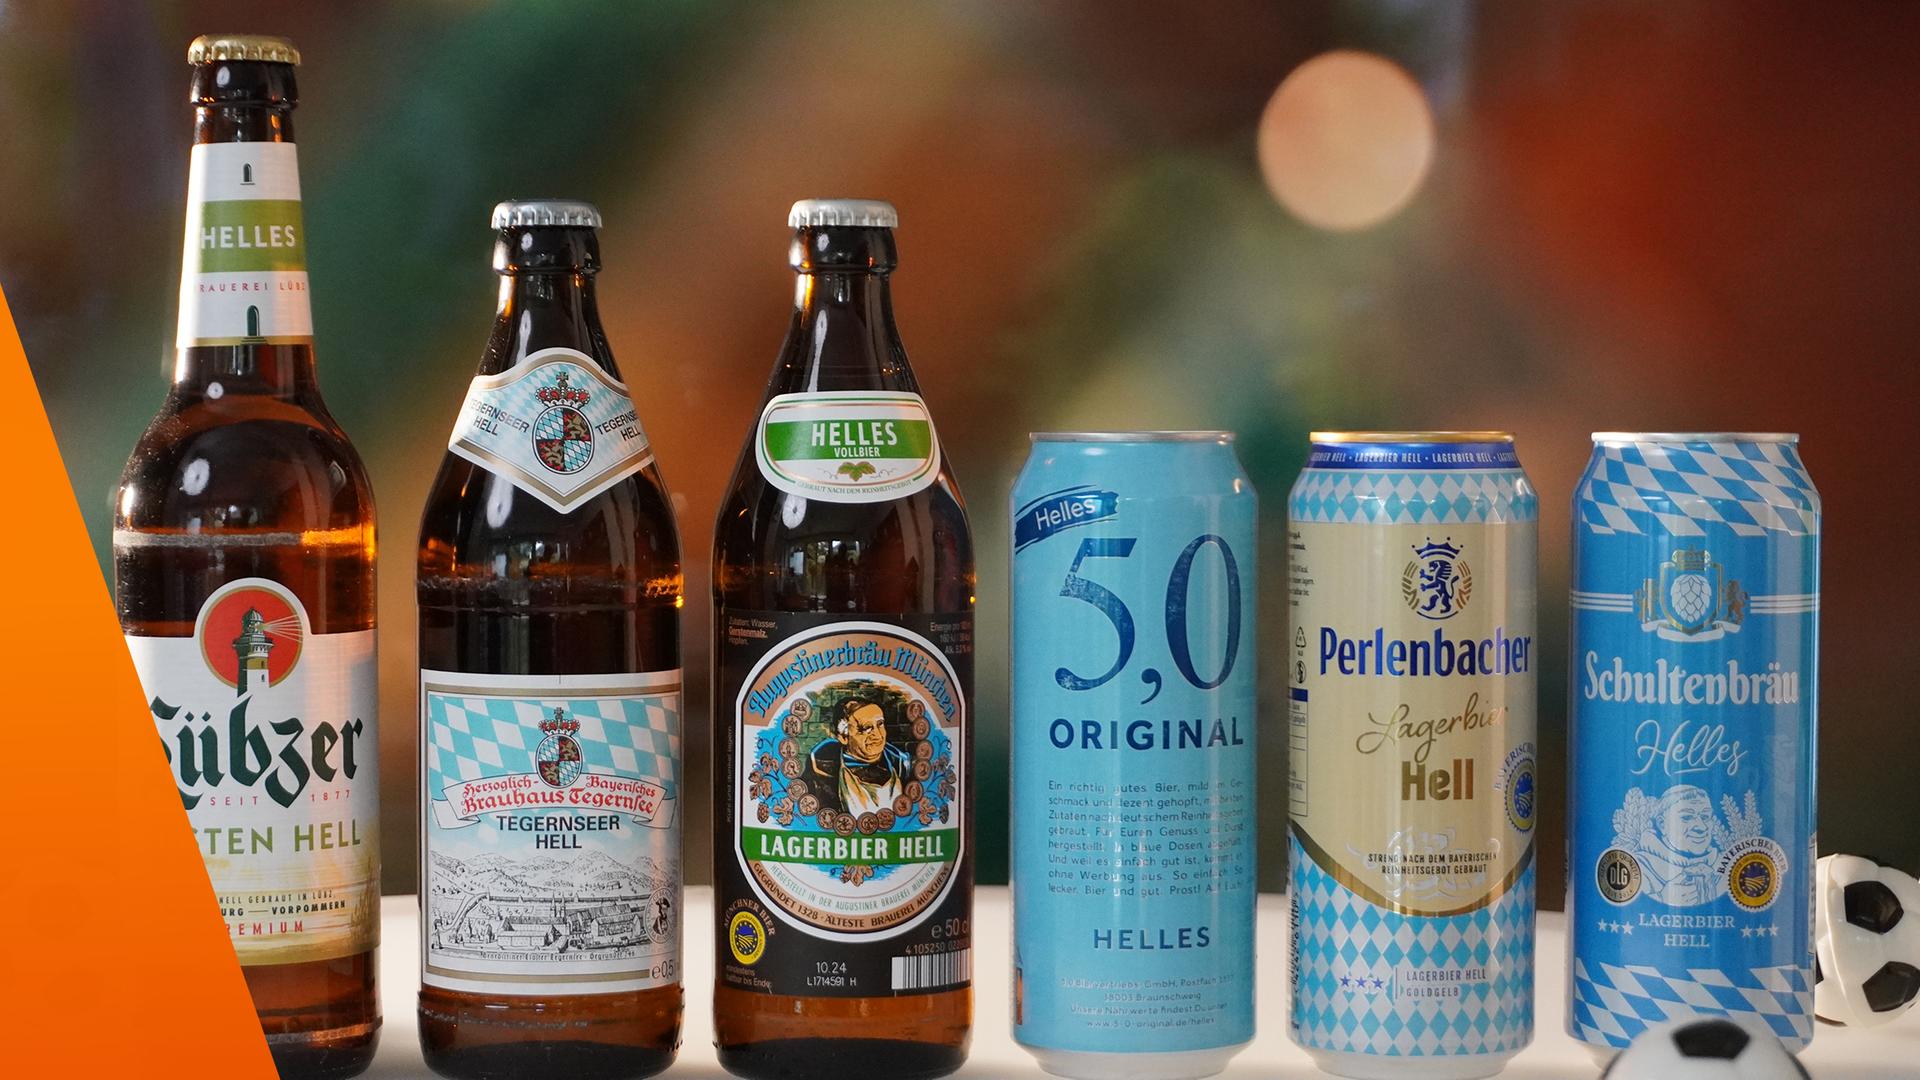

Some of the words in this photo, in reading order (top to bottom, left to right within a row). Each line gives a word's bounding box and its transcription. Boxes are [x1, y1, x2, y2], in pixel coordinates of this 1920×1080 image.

[200, 225, 296, 249] HELLES
[199, 282, 269, 292] RAUEREI
[473, 416, 498, 437] HELL
[621, 426, 641, 441] HELL
[811, 422, 898, 447] HELLES
[834, 447, 881, 458] VOLLBIER
[1331, 452, 1346, 462] HELL
[1354, 451, 1398, 463] LAGERBIER
[1402, 452, 1421, 463] HELL
[1432, 452, 1475, 463] LAGERBIER
[1477, 452, 1493, 463] HELL
[1036, 496, 1097, 532] Helles
[1054, 533, 1242, 706] 5,0
[1320, 627, 1531, 676] Perlenbacher
[748, 640, 891, 719] Augustinerbräu
[892, 647, 956, 721] München
[1584, 650, 1799, 705] Schultenbräu
[1049, 717, 1244, 750] ORIGINAL
[1631, 719, 1748, 777] Helles
[1048, 780, 1062, 790] Ein
[1069, 782, 1105, 794] richtig
[1188, 781, 1209, 791] mild
[1402, 758, 1474, 801] Hell
[210, 796, 259, 806] SEIT
[311, 789, 351, 802] 1877
[461, 788, 565, 816] Brauhaus
[1048, 796, 1088, 807] schmack
[1092, 798, 1113, 808] und
[1157, 796, 1203, 809] gehopft,
[1048, 809, 1087, 820] Zutaten
[1088, 811, 1115, 822] nach
[496, 815, 620, 832] TEGERNSEER
[193, 826, 273, 855] TEN
[294, 819, 361, 853] HELL
[1120, 826, 1153, 837] Euren
[1160, 826, 1199, 837] Genuss
[536, 834, 582, 849] HELL
[761, 834, 888, 860] LAGERBIER
[899, 835, 944, 858] HELL
[1168, 841, 1203, 851] Dosen
[1048, 854, 1067, 864] Und
[1072, 856, 1092, 865] weil
[1096, 858, 1109, 866] es
[1115, 856, 1156, 867] einfach
[1161, 857, 1180, 868] gut
[1368, 853, 1399, 863] STRENG
[1403, 853, 1425, 864] NACH
[1428, 853, 1446, 864] DEM
[1717, 838, 1773, 874] BAYERISCHES
[1048, 869, 1074, 879] ohne
[1080, 870, 1135, 883] Werbung
[1173, 870, 1188, 880] So
[1381, 864, 1451, 875] REINHEITSGEBOT
[1454, 863, 1487, 874] GEBRAUT
[1610, 861, 1628, 885] DLG
[770, 864, 806, 897] HERGESTELLT
[808, 893, 817, 902] IN
[819, 897, 832, 907] DER
[836, 900, 879, 911] AUGUSTINER
[881, 889, 911, 907] BRAUEREI
[1085, 885, 1106, 895] Bier
[1113, 886, 1135, 897] und
[248, 893, 292, 904] GEBRAUT
[298, 892, 307, 901] IN
[753, 863, 796, 908] GEGRÜNDET
[798, 905, 819, 920] 1328
[825, 914, 865, 928] ÄLTESTE
[871, 904, 915, 926] BRAUEREI
[271, 900, 346, 915] VORPOMMERN
[760, 910, 776, 936] BIER
[945, 918, 960, 937] 50
[1638, 913, 1735, 929] LAGERBIER
[1093, 927, 1210, 950] HELLES
[1663, 933, 1710, 947] HELL
[816, 961, 848, 973] 10.24
[850, 977, 857, 986] H
[1406, 969, 1461, 982] LAGERBIER
[1465, 968, 1486, 981] HELL
[1135, 992, 1202, 1003] Braunschweig
[1406, 987, 1459, 998] GOLDGELB
[1161, 1003, 1193, 1014] findest
